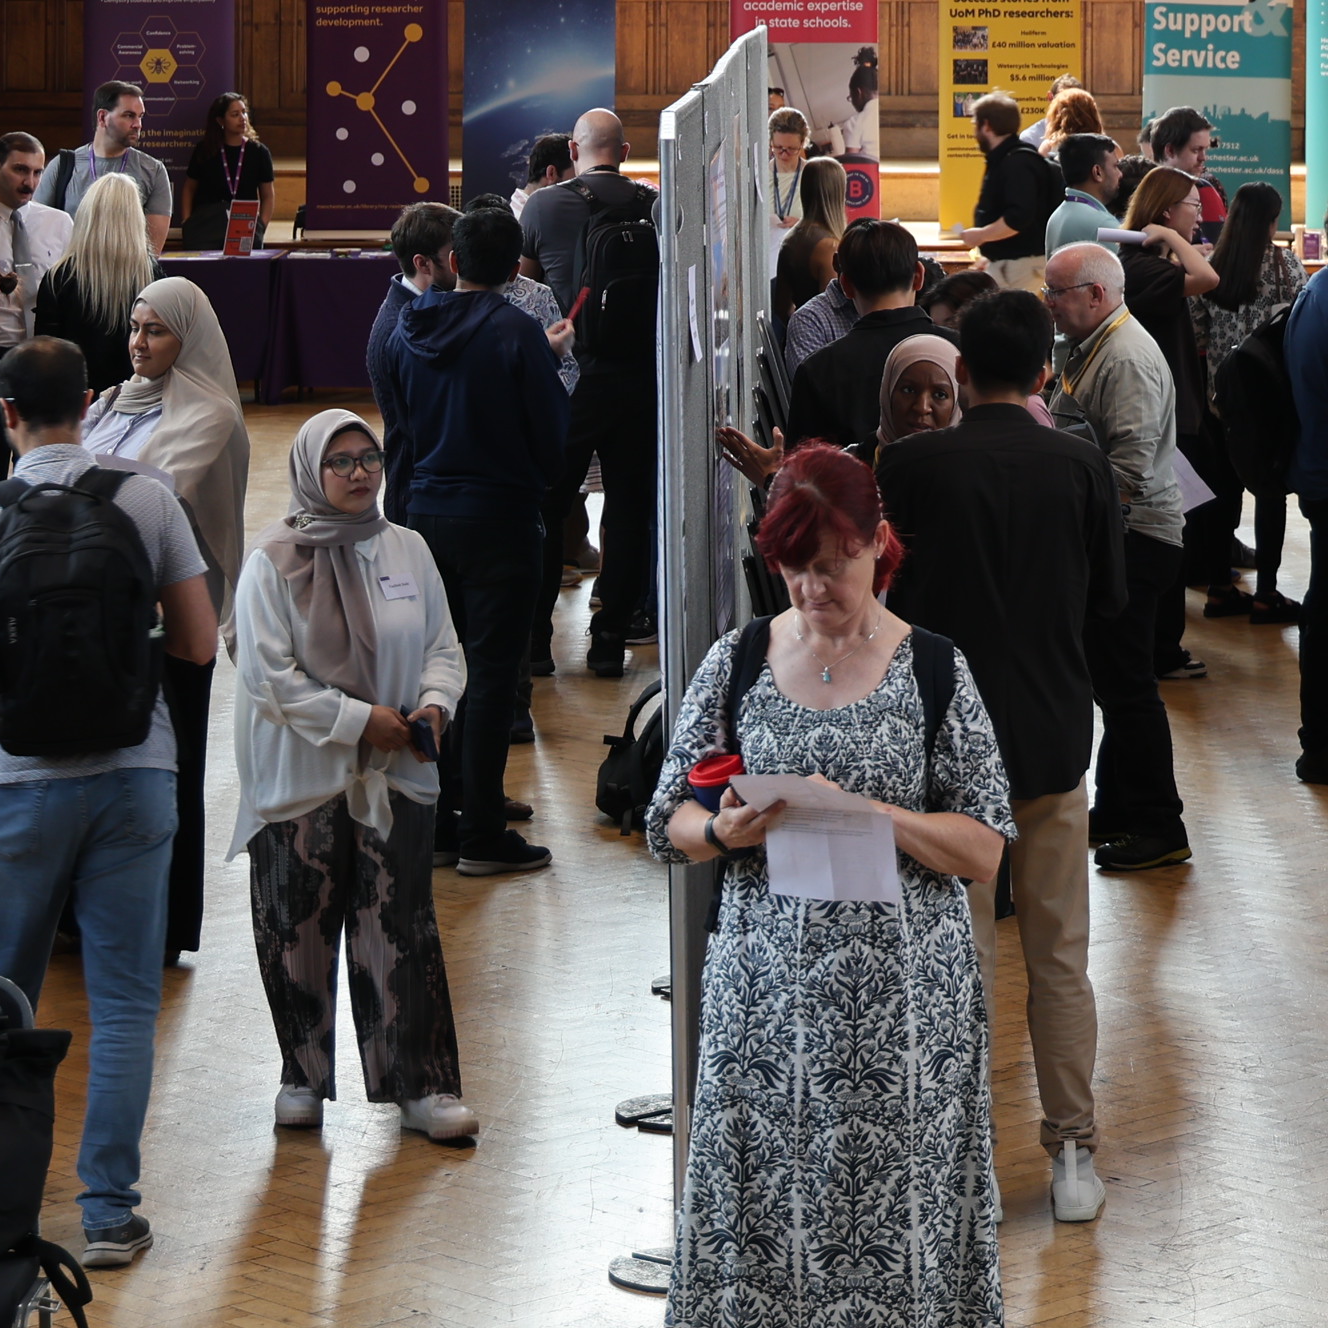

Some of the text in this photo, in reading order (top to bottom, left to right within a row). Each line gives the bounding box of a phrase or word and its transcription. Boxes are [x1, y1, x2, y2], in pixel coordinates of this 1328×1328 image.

[316, 4, 423, 14] supporting researcher
[744, 0, 863, 13] academic expertise
[950, 9, 1073, 18] UoM PhD researchers:
[316, 18, 383, 28] development.
[755, 16, 851, 27] in state schools.
[1153, 6, 1252, 38] Support
[1152, 43, 1240, 69] Service
[147, 128, 161, 137] the
